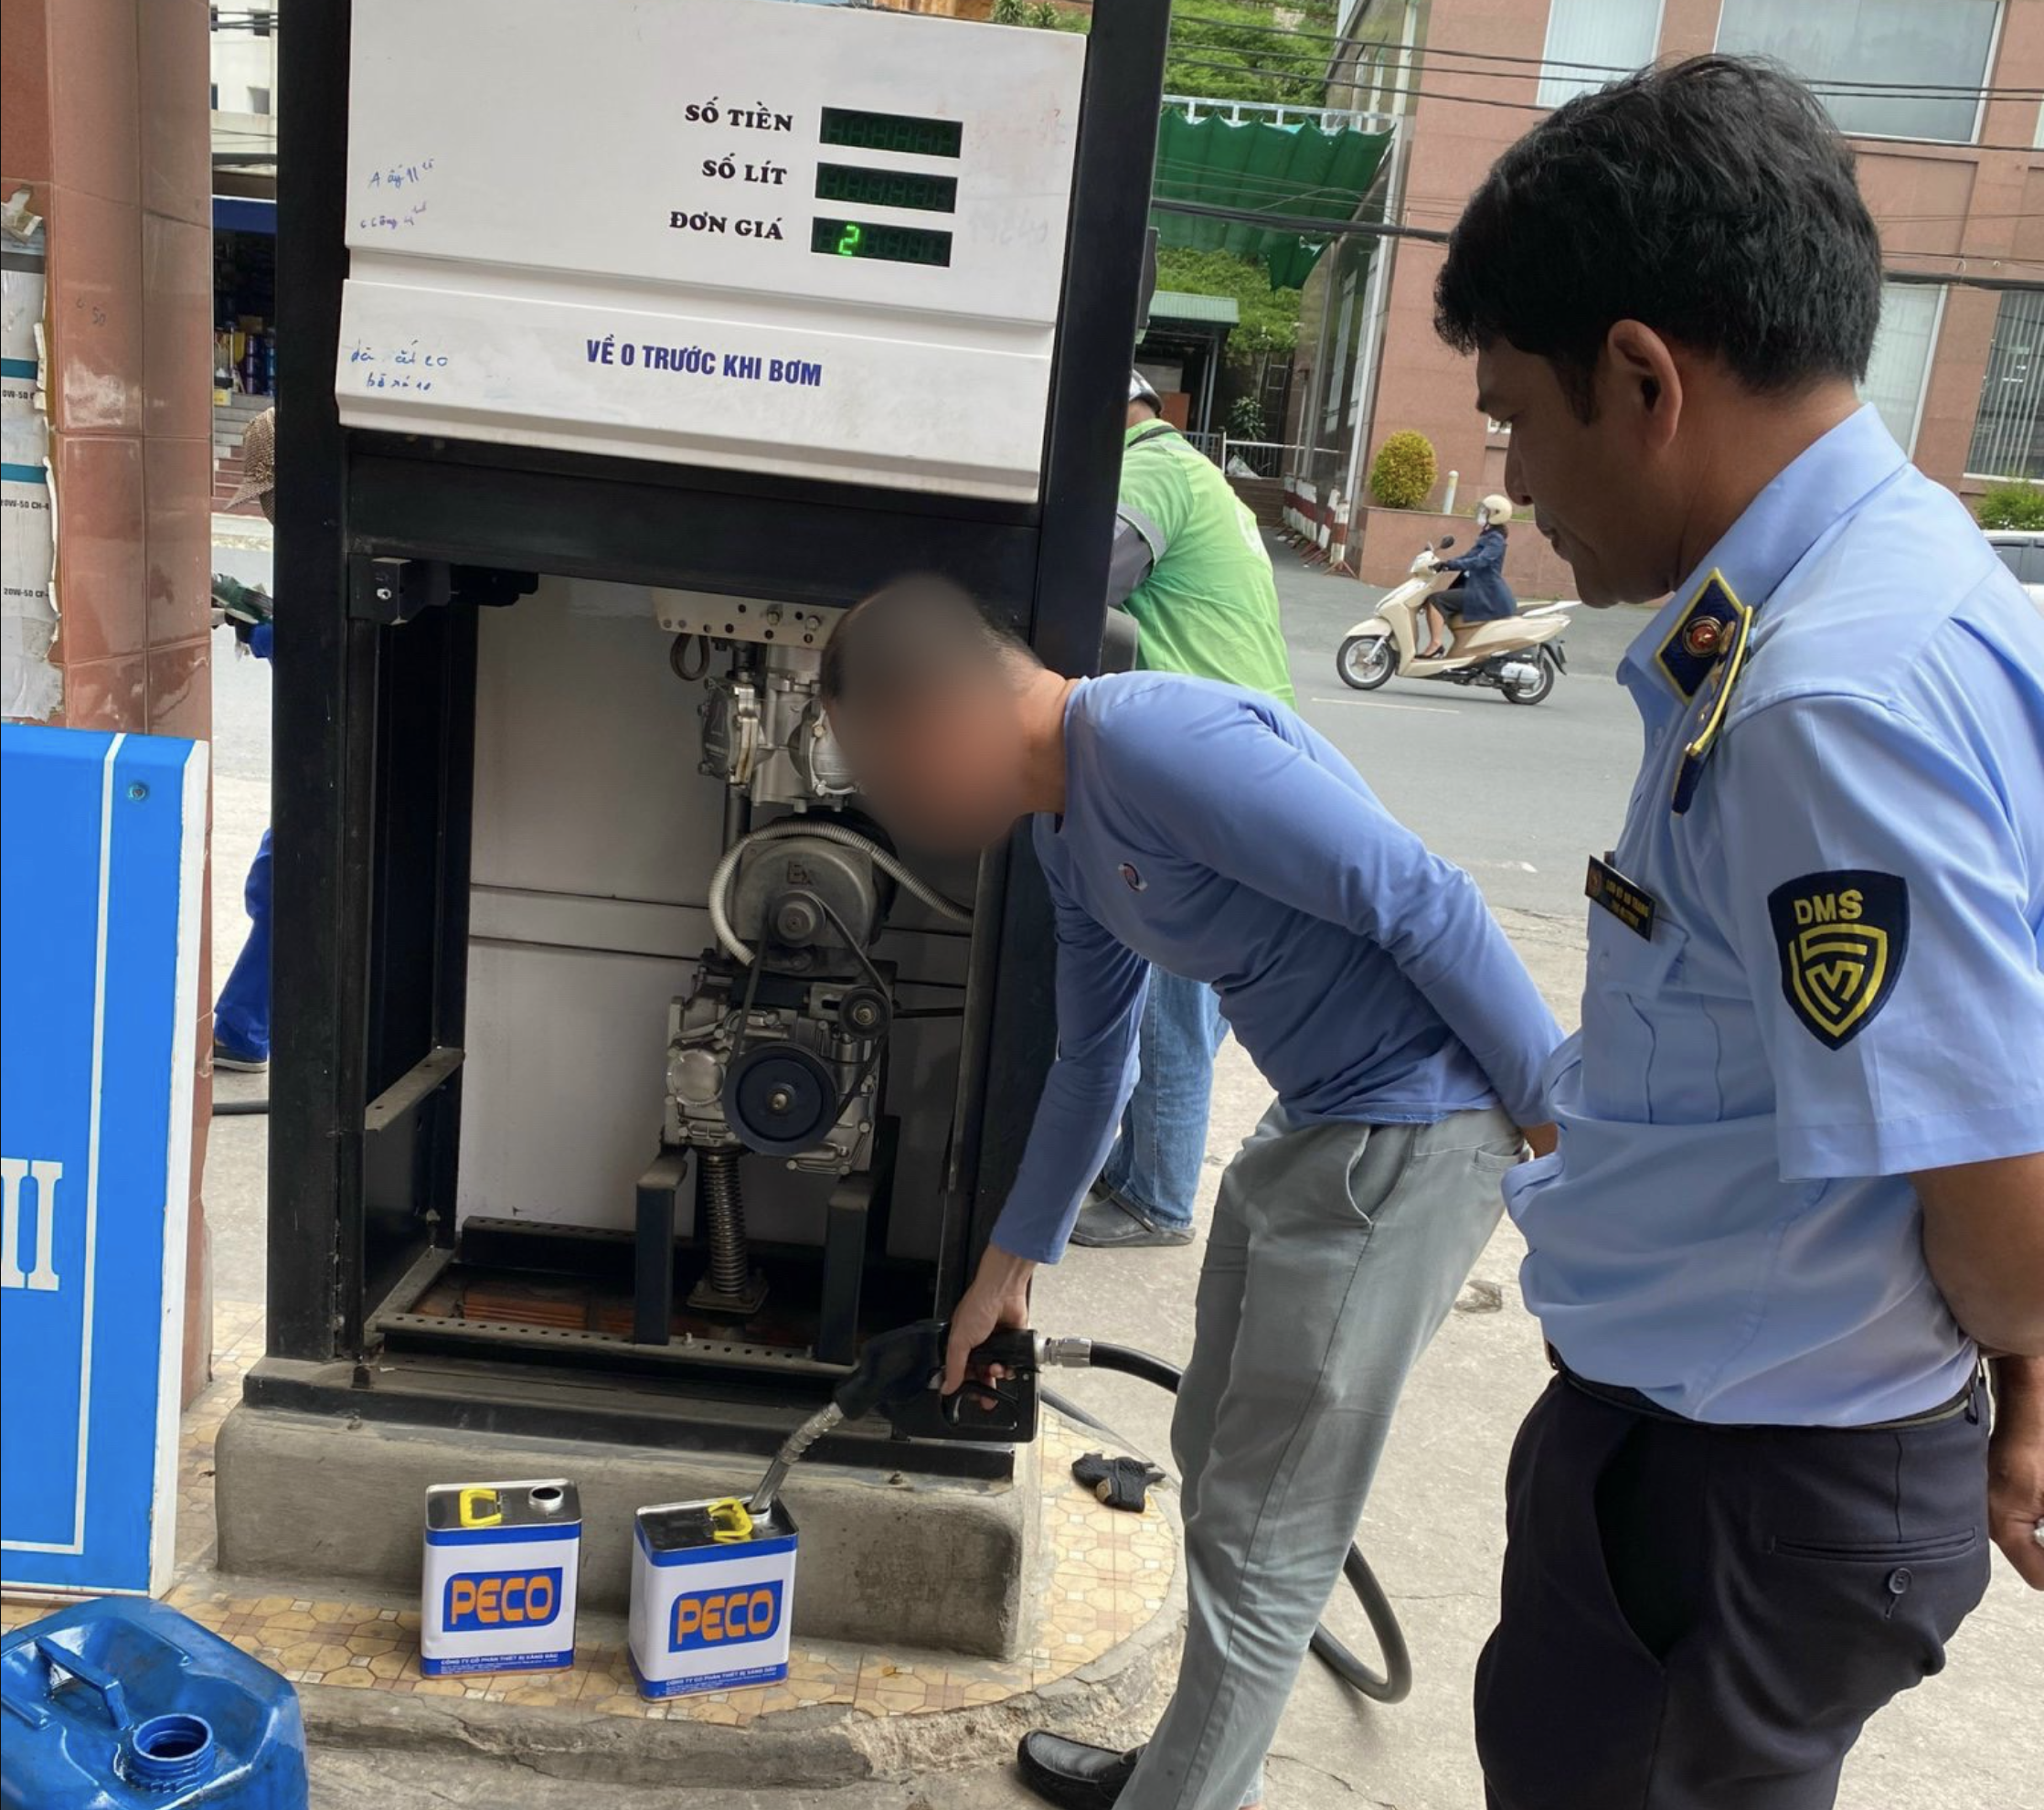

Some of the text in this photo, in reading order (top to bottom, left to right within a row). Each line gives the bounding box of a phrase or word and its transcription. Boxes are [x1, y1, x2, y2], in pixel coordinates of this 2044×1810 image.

[685, 96, 793, 133] SỐ TIỀN
[701, 153, 788, 186] SỐ LÍT
[669, 210, 783, 240] ĐƠN GIÁ
[836, 224, 860, 256] 2
[586, 334, 615, 366] VỀ
[642, 345, 716, 376] TRƯỚC
[722, 353, 762, 380] KHI
[769, 358, 823, 387] BƠM
[1794, 889, 1864, 925] DMS
[451, 1575, 553, 1625] PECO
[676, 1589, 774, 1645] PECO
